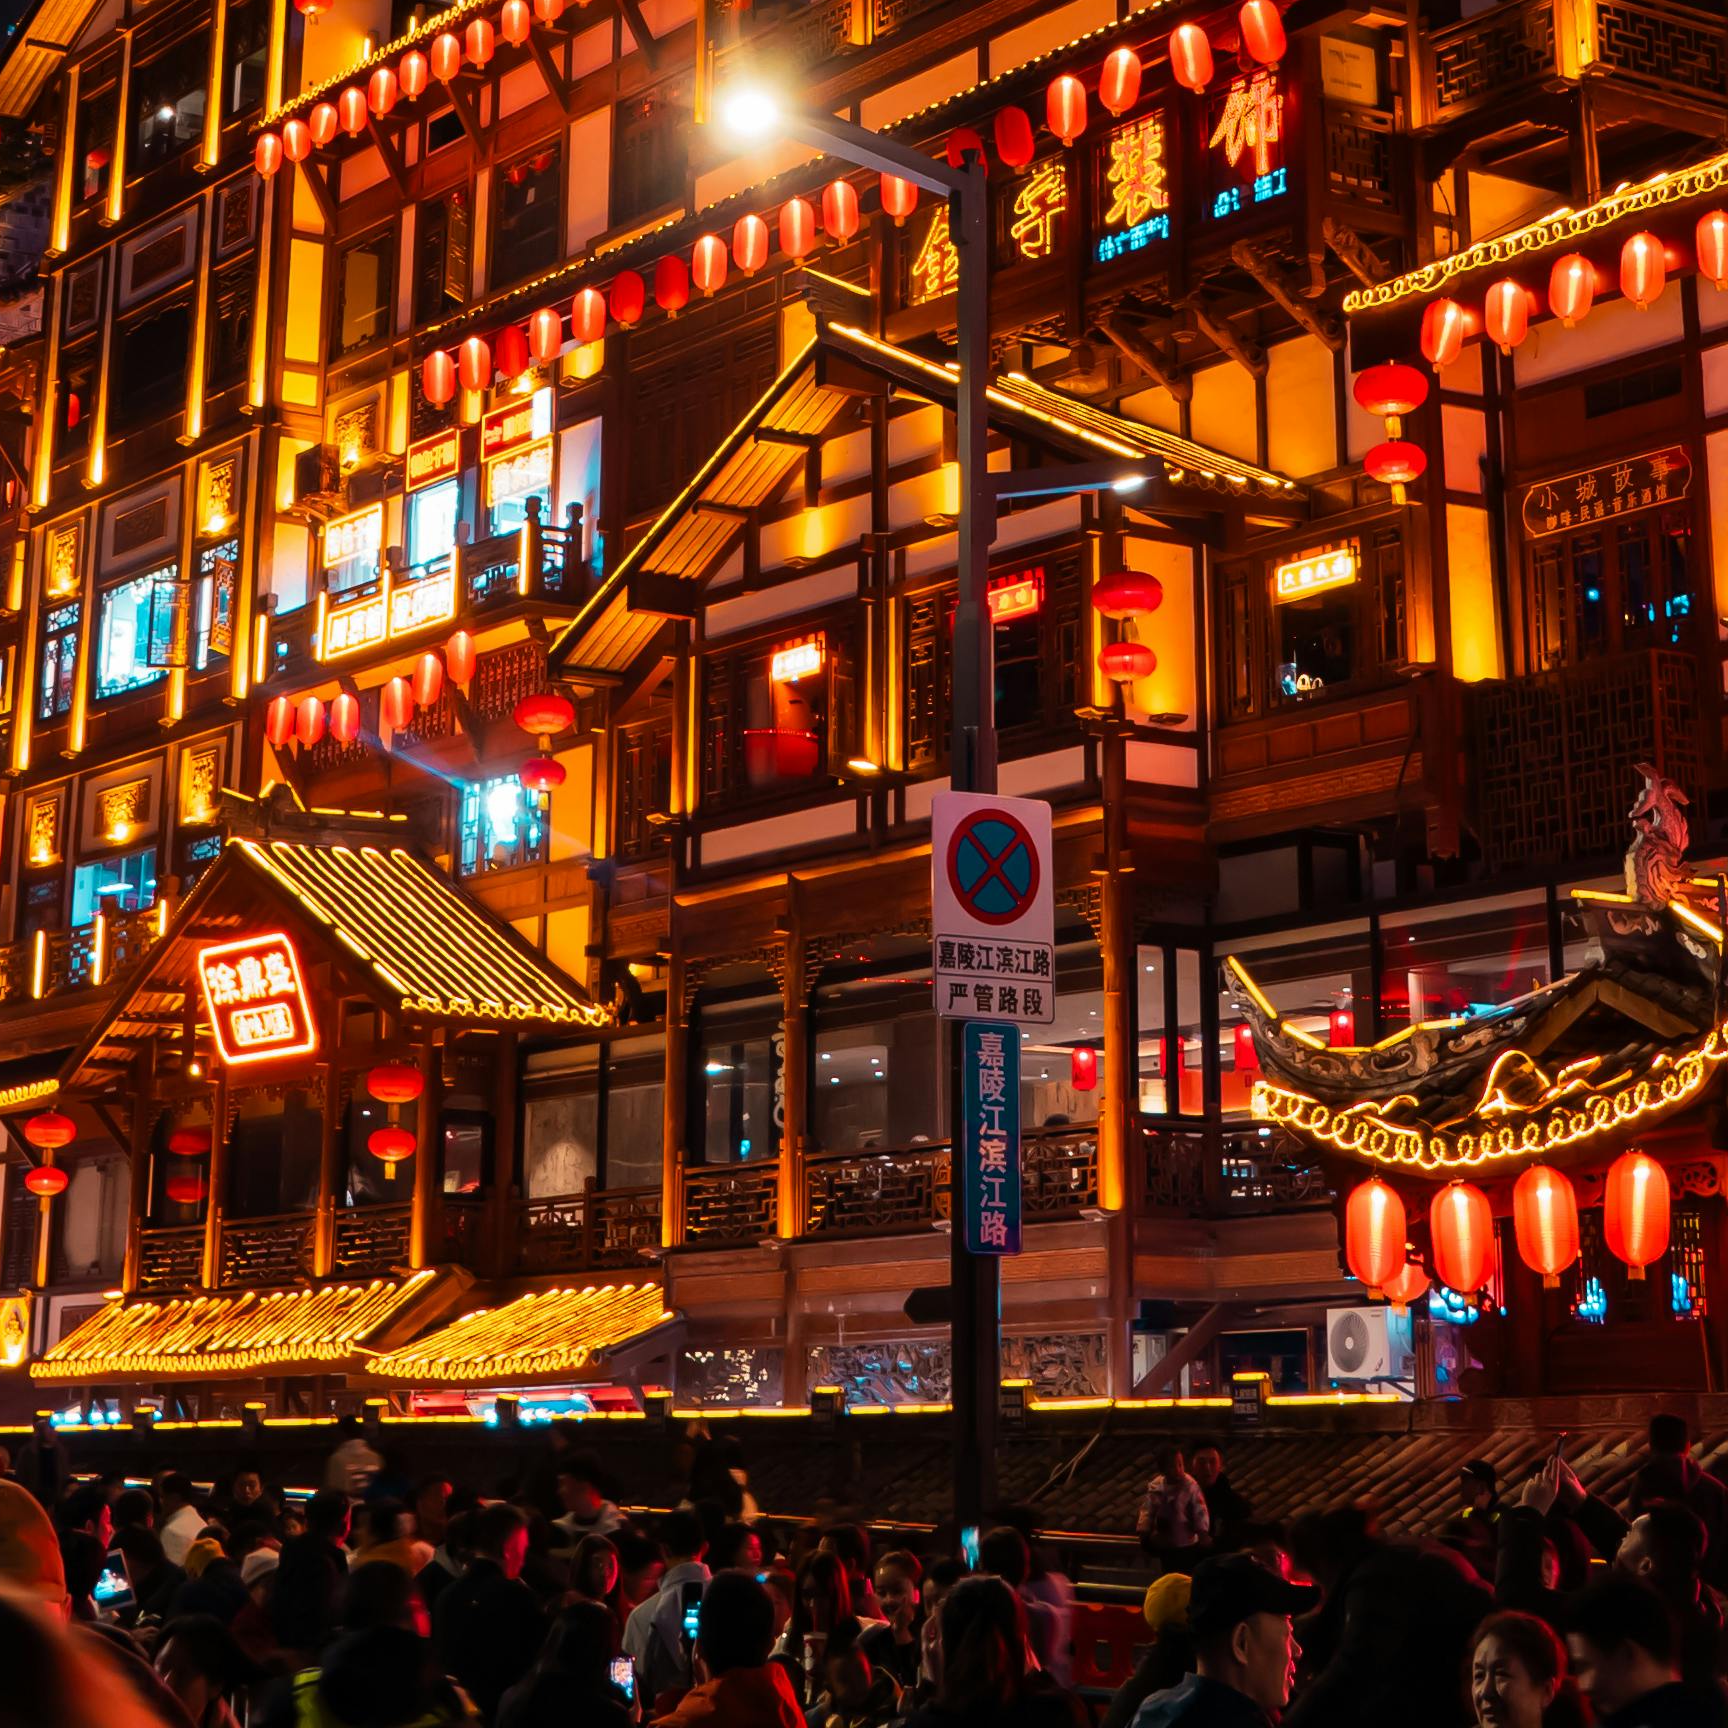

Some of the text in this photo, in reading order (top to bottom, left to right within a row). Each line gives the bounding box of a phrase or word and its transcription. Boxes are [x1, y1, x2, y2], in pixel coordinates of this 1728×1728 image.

[1539, 455, 1670, 510] 小城故事
[206, 952, 296, 1005] 徐鼎盛
[938, 940, 1050, 977] 嘉陵江滨江路
[948, 982, 1043, 1016] 严管路段
[977, 1032, 1008, 1248] 嘉陵江滨江路
